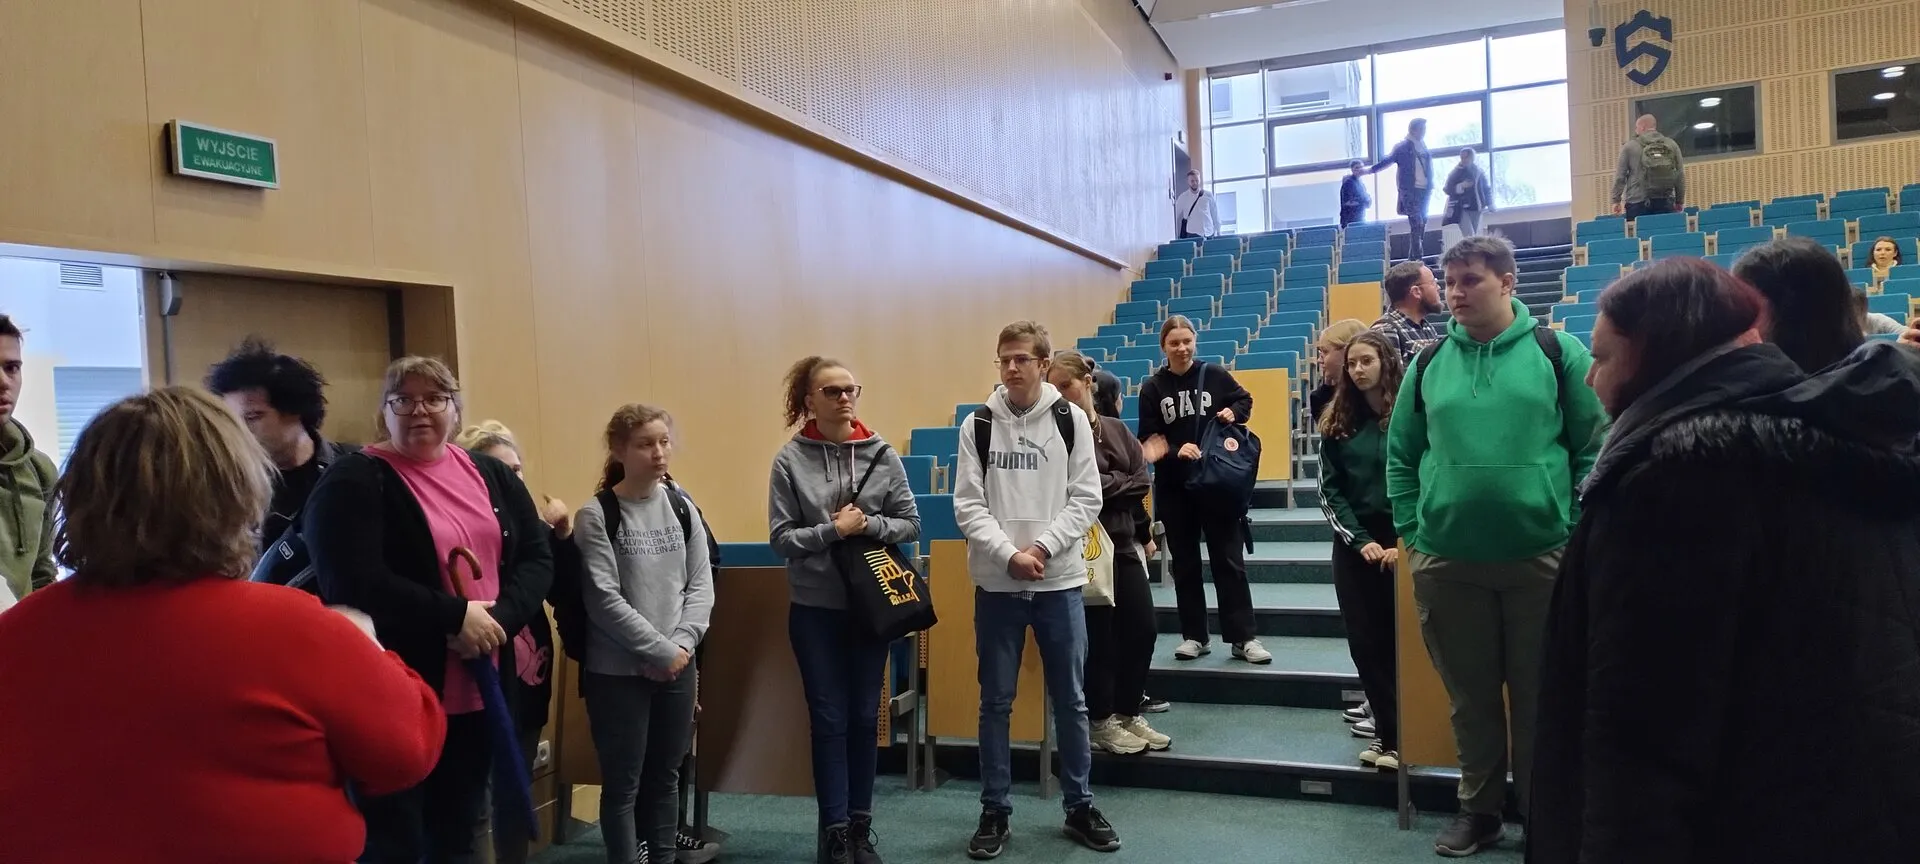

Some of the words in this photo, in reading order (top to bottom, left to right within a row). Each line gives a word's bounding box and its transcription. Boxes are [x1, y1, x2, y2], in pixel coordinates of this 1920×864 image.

[193, 153, 264, 176] EWAKUACYJNE
[1160, 388, 1212, 425] GAP
[987, 451, 1038, 470] PUMA
[617, 529, 642, 539] CALVIN
[642, 528, 663, 539] KLEIN
[619, 538, 644, 547] CALVIN
[644, 537, 666, 547] KLEIN
[619, 546, 647, 556] CALVIN
[647, 545, 668, 555] KLEIN
